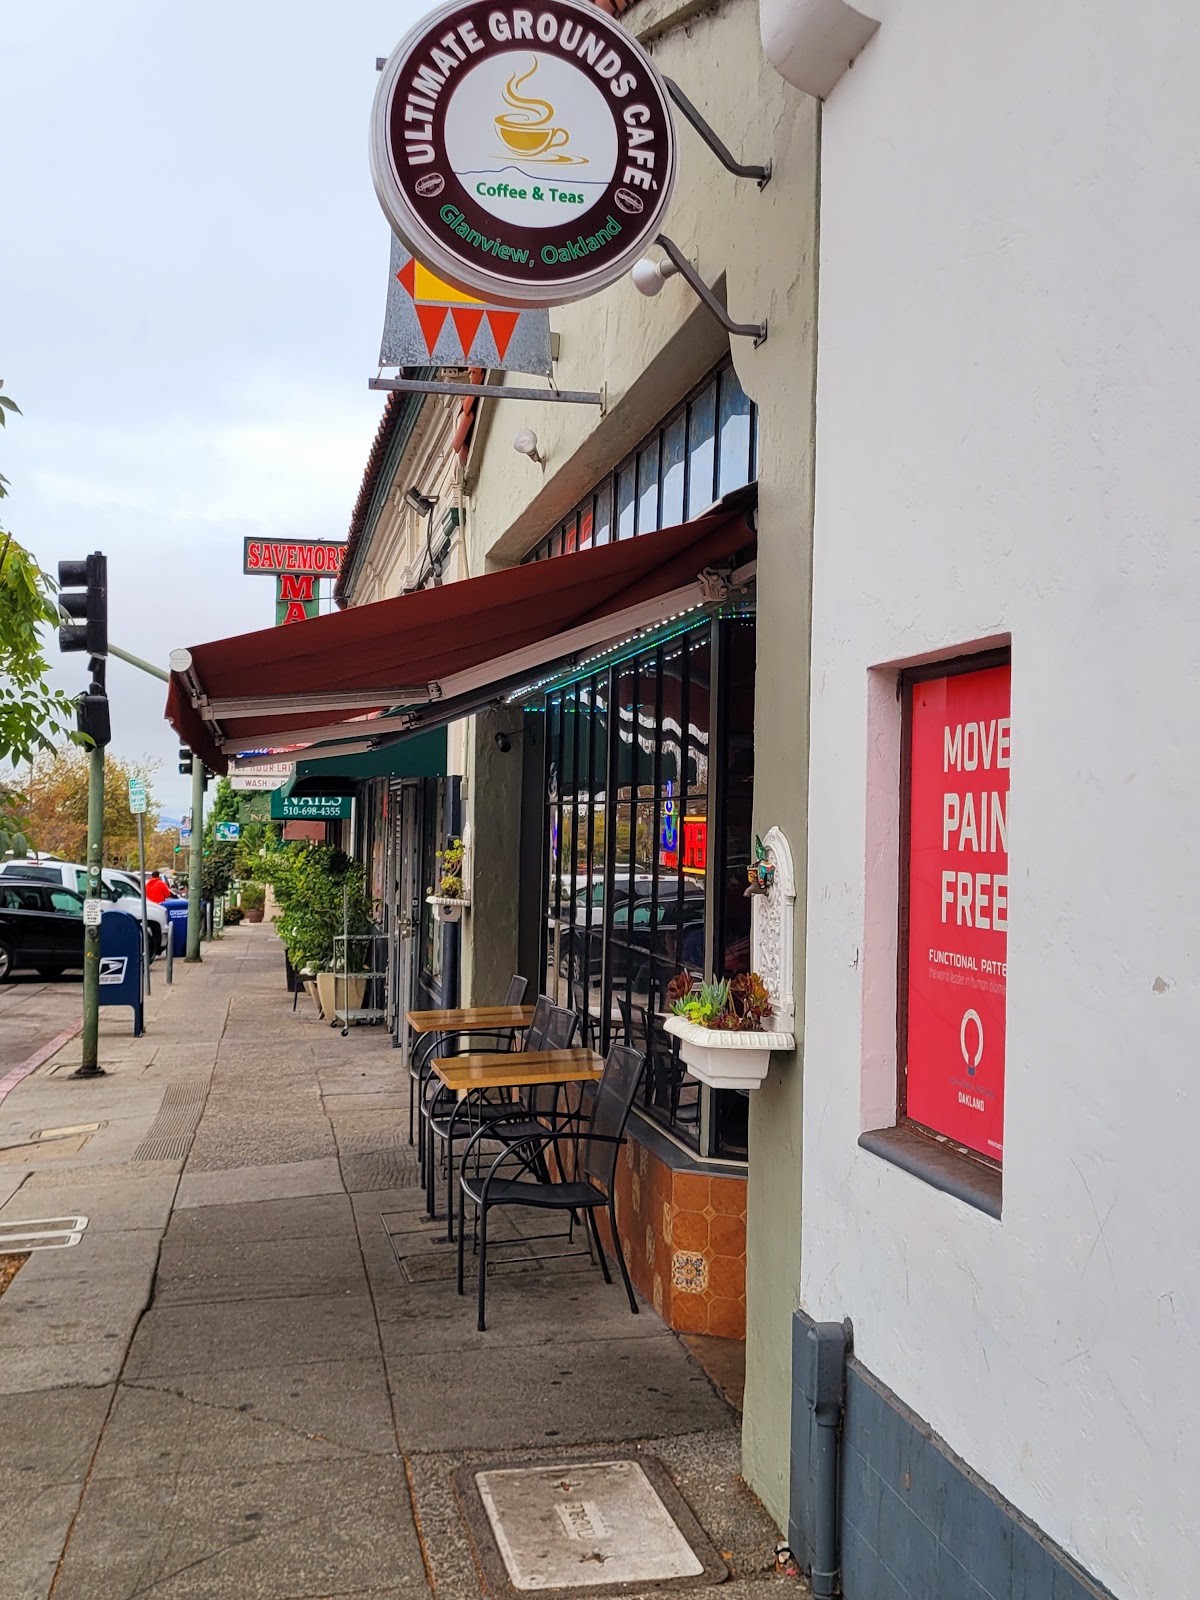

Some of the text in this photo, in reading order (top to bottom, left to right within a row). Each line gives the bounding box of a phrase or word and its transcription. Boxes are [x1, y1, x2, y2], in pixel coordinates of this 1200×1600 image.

[404, 8, 659, 192] ULTIMATE GROUNDS CAFÉ
[476, 182, 584, 204] Coffee & Teas
[439, 204, 623, 267] Glanview, Oakland
[943, 718, 1011, 773] MOVE
[245, 779, 267, 787] WASH
[283, 796, 342, 806] NAILS
[283, 806, 341, 816] 510-698-4355
[943, 790, 1010, 853] PAIN
[941, 870, 1009, 932] FREE
[929, 948, 978, 971] FUNCTIONAL
[958, 1091, 985, 1112] OAKLAND
